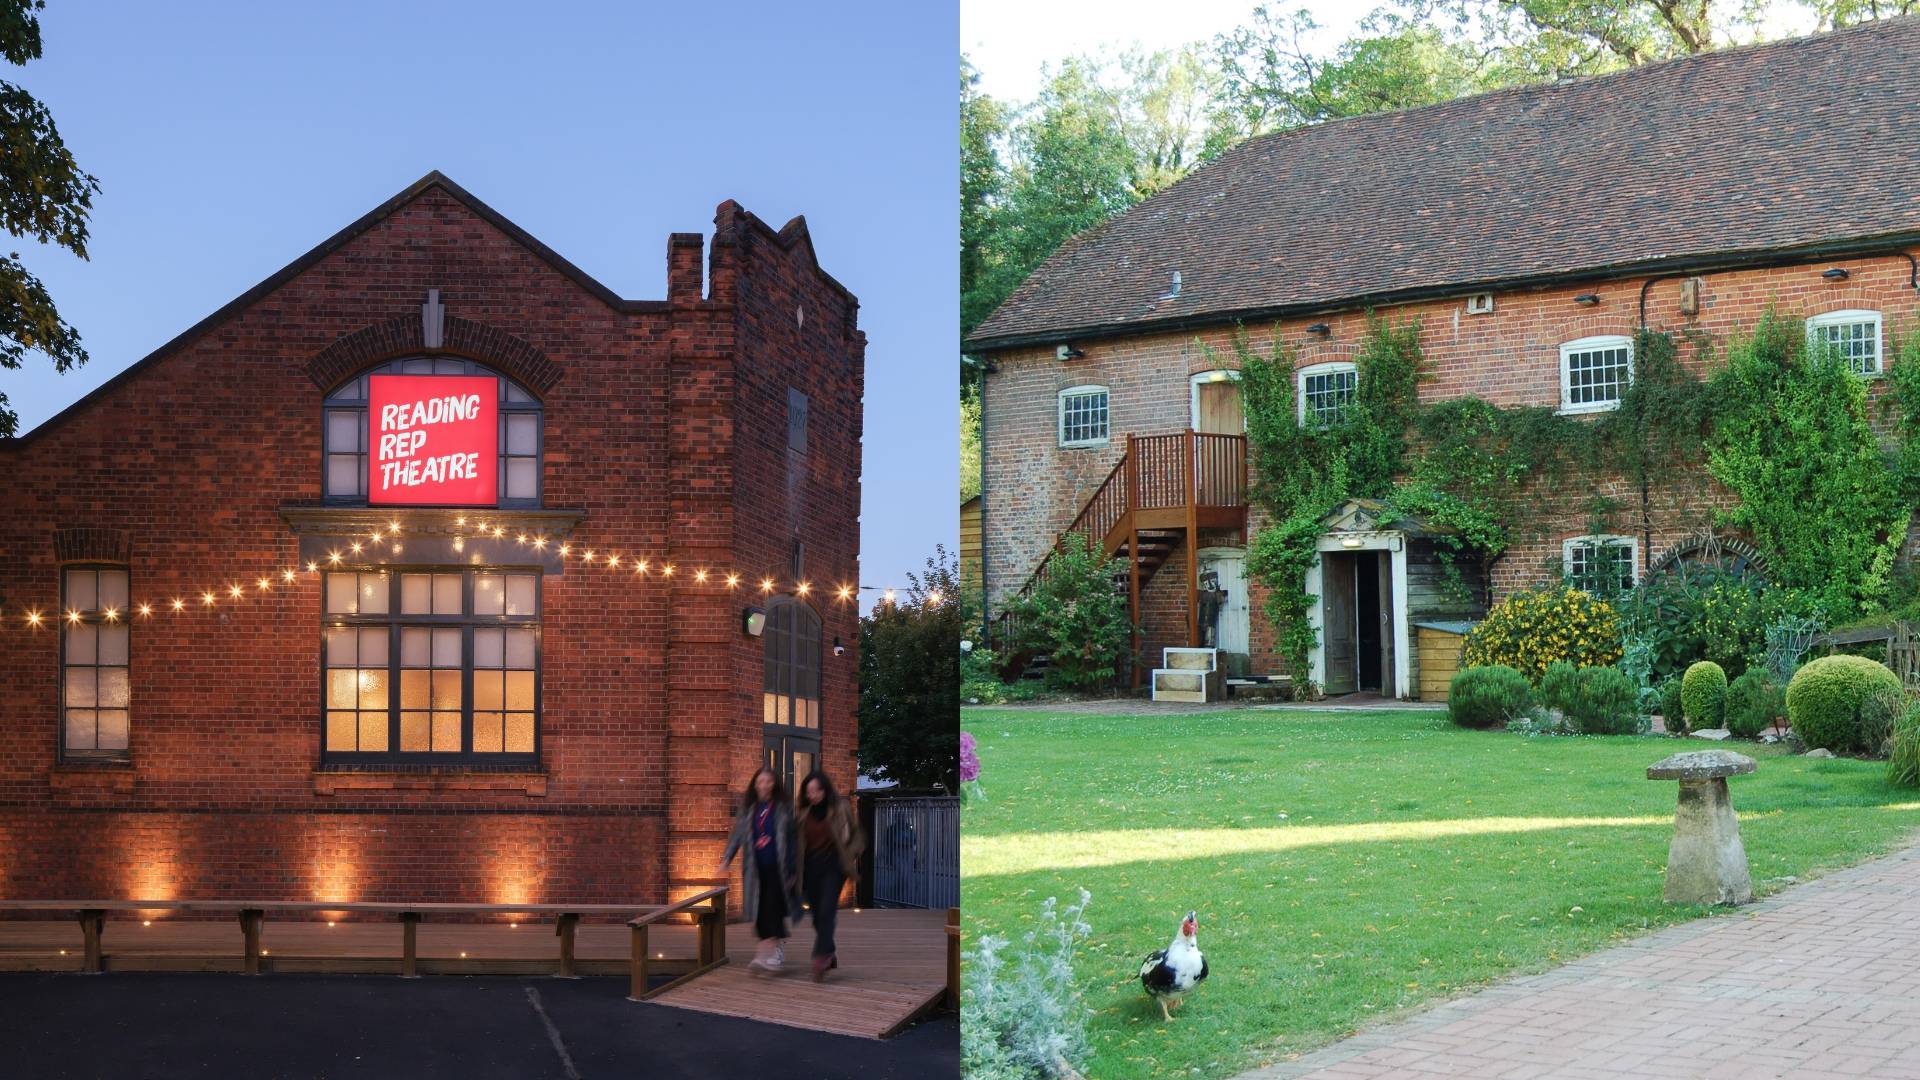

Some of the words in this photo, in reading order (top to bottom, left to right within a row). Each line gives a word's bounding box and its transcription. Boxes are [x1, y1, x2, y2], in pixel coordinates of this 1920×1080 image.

[381, 394, 480, 431] READING
[379, 430, 427, 460] REP
[380, 452, 479, 490] THEATRE
